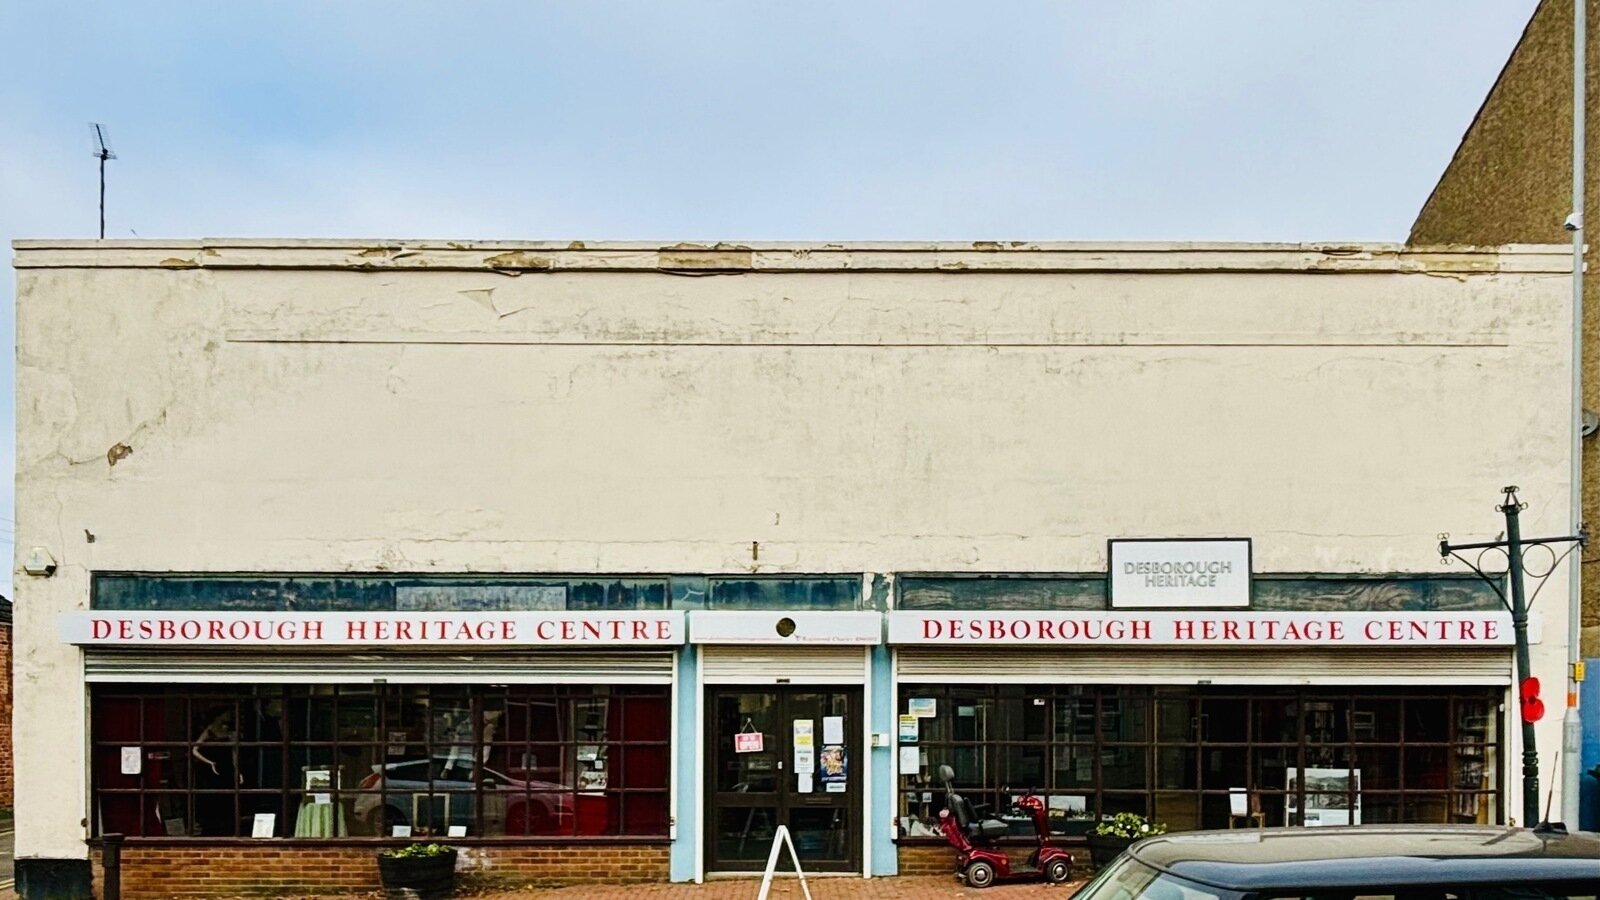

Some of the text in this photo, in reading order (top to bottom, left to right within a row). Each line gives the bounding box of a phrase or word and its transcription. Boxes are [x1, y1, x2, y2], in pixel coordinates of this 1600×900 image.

[1124, 562, 1232, 574] DESBOROUGH
[1145, 575, 1217, 587] HERITAGE
[92, 620, 672, 640] DESBOROUGH HERITAGE CENTRE
[922, 621, 1499, 640] DESBOROUGH HERITAGE CENTRE
